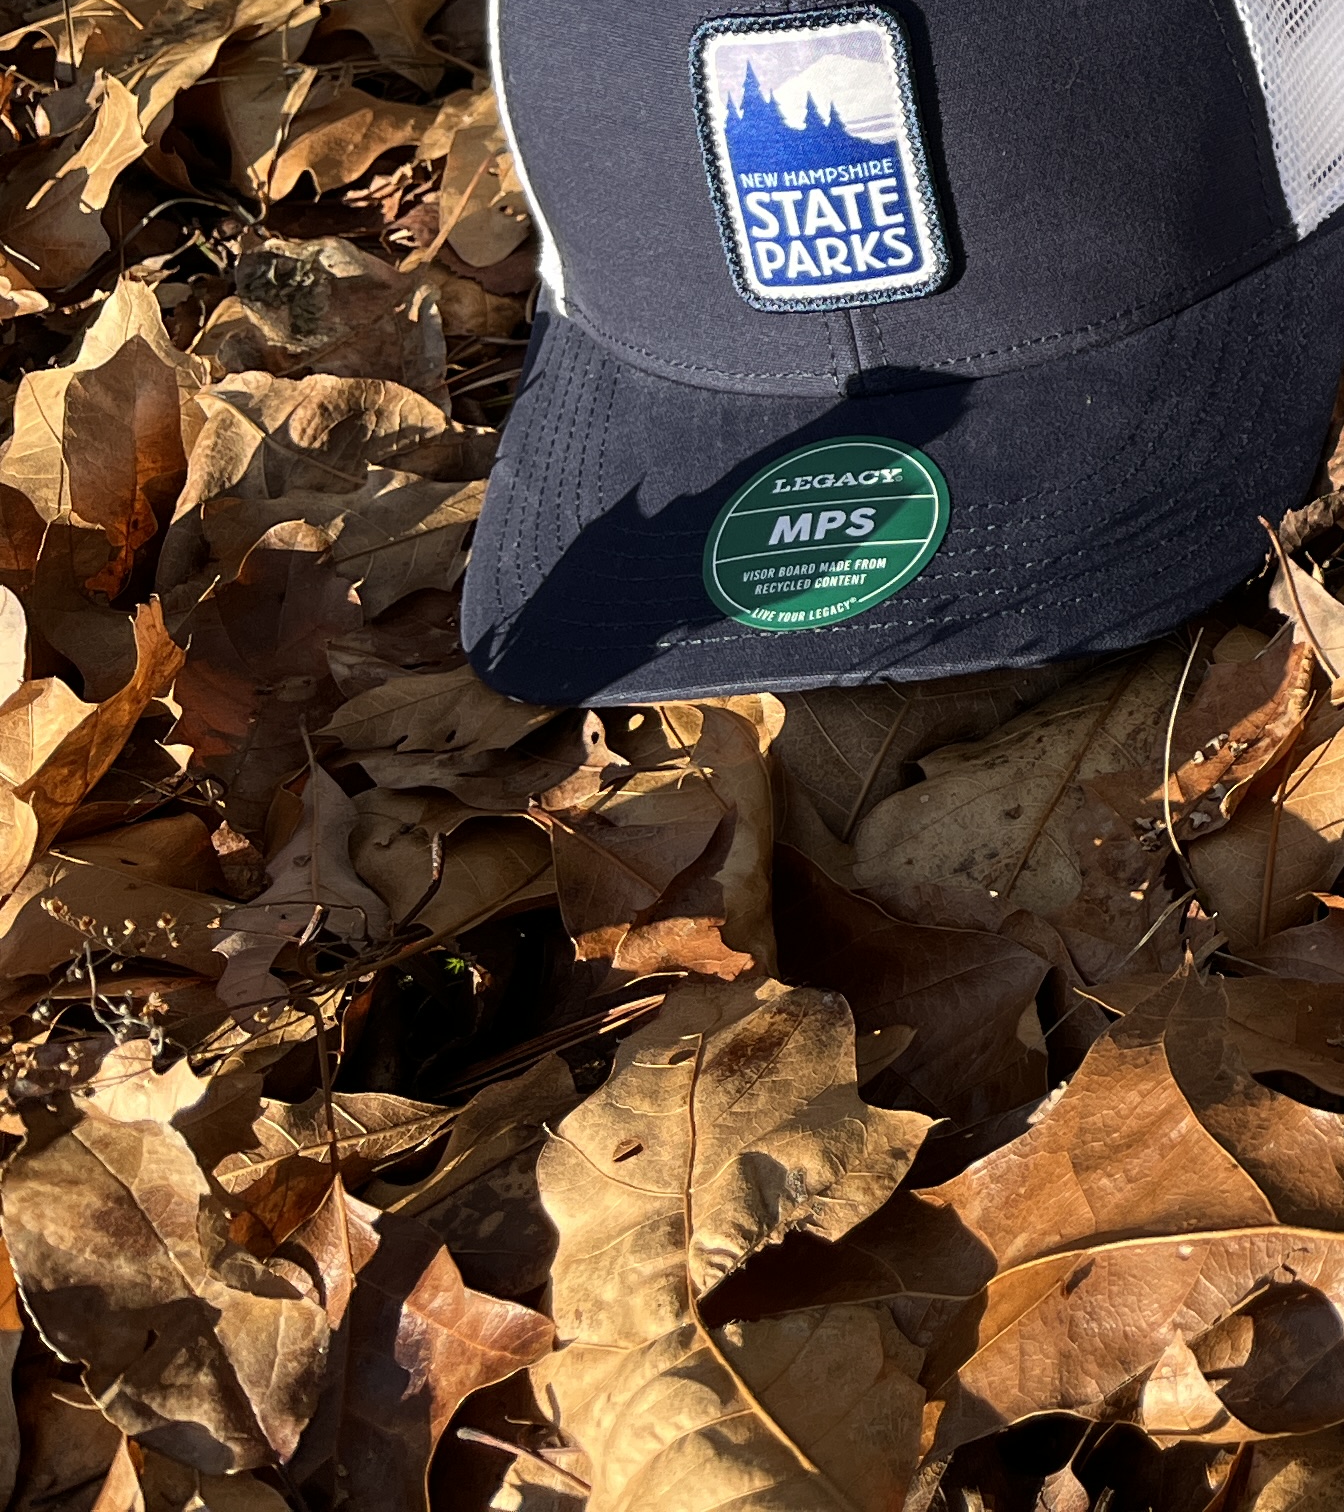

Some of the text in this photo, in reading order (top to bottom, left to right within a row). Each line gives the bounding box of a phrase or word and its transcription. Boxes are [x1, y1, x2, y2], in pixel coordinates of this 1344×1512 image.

[740, 159, 894, 189] NEW HAMPSHIRE
[744, 178, 904, 238] STATE
[755, 227, 913, 279] PARKS
[768, 507, 877, 545] MPS
[743, 557, 887, 582] VISOR BOARD MADE FROM
[754, 573, 867, 595] RECYCLED CONTENT
[751, 607, 776, 622] LIVE
[778, 611, 805, 623] YOUR
